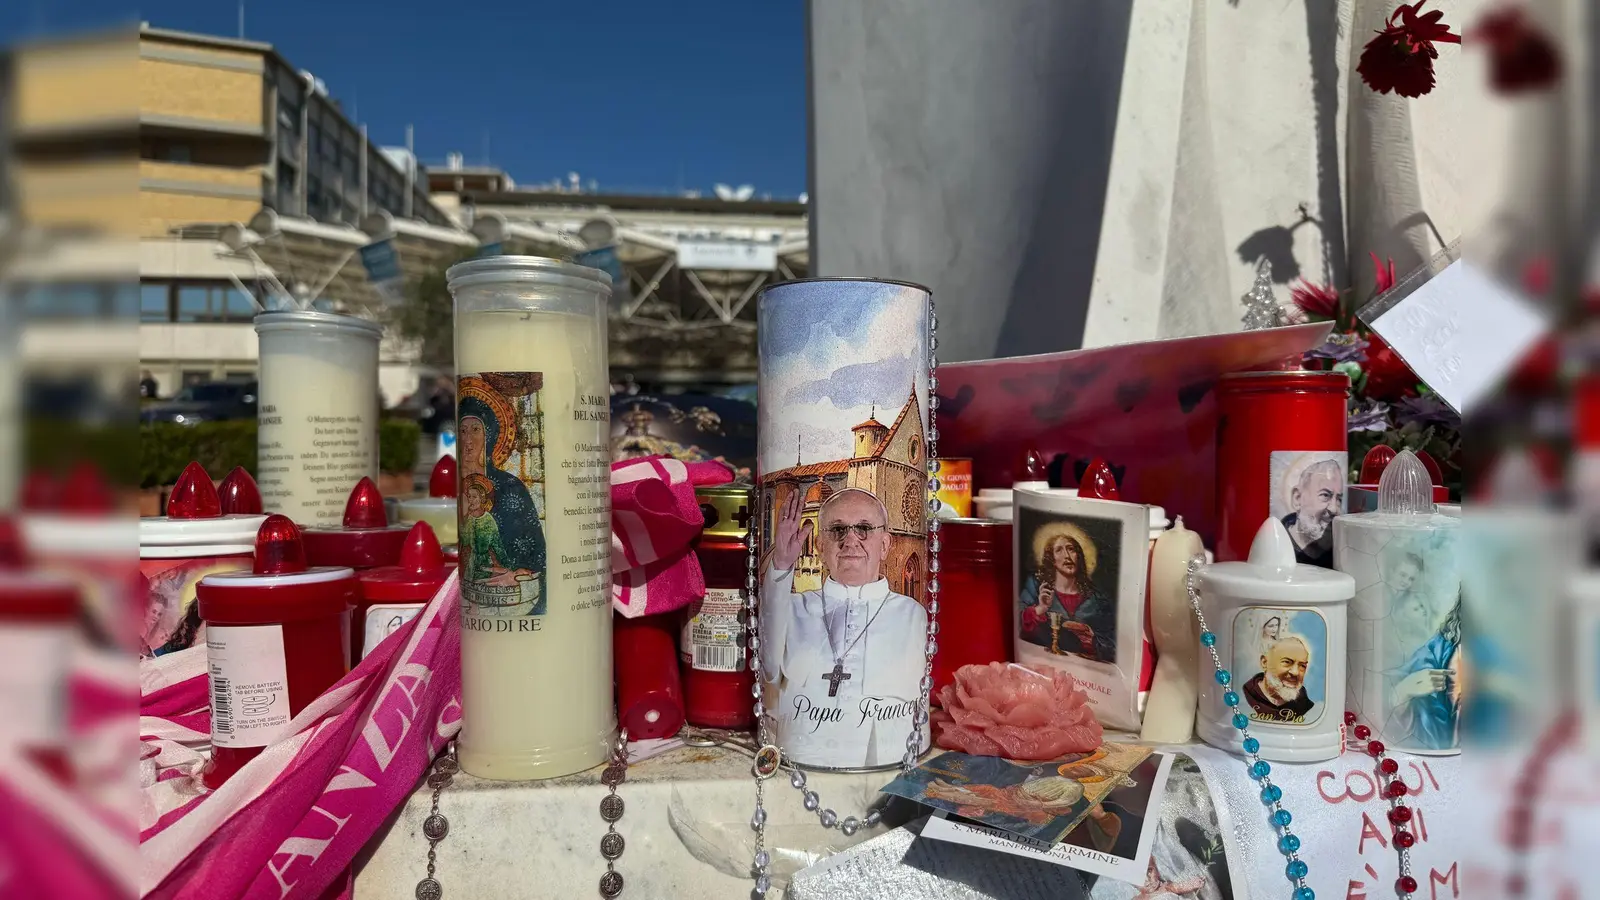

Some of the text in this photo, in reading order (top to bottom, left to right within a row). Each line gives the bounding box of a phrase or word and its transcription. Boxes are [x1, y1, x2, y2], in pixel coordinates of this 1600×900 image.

[574, 410, 590, 421] DEL
[561, 458, 571, 469] che
[568, 475, 592, 486] bagnando
[563, 506, 587, 516] benedici
[561, 554, 577, 564] Dona
[562, 570, 572, 581] nel
[577, 585, 590, 595] dove
[576, 600, 590, 611] dolce
[496, 619, 512, 632] DI
[519, 618, 541, 632] RE
[257, 681, 281, 689] BATTERY
[1072, 677, 1112, 696] PASQUALE
[793, 694, 844, 734] Papa
[1250, 704, 1306, 723] San Pio
[951, 822, 1120, 867] S. MARIA DEL CARMINE
[988, 838, 1073, 862] MANFREDONIA
